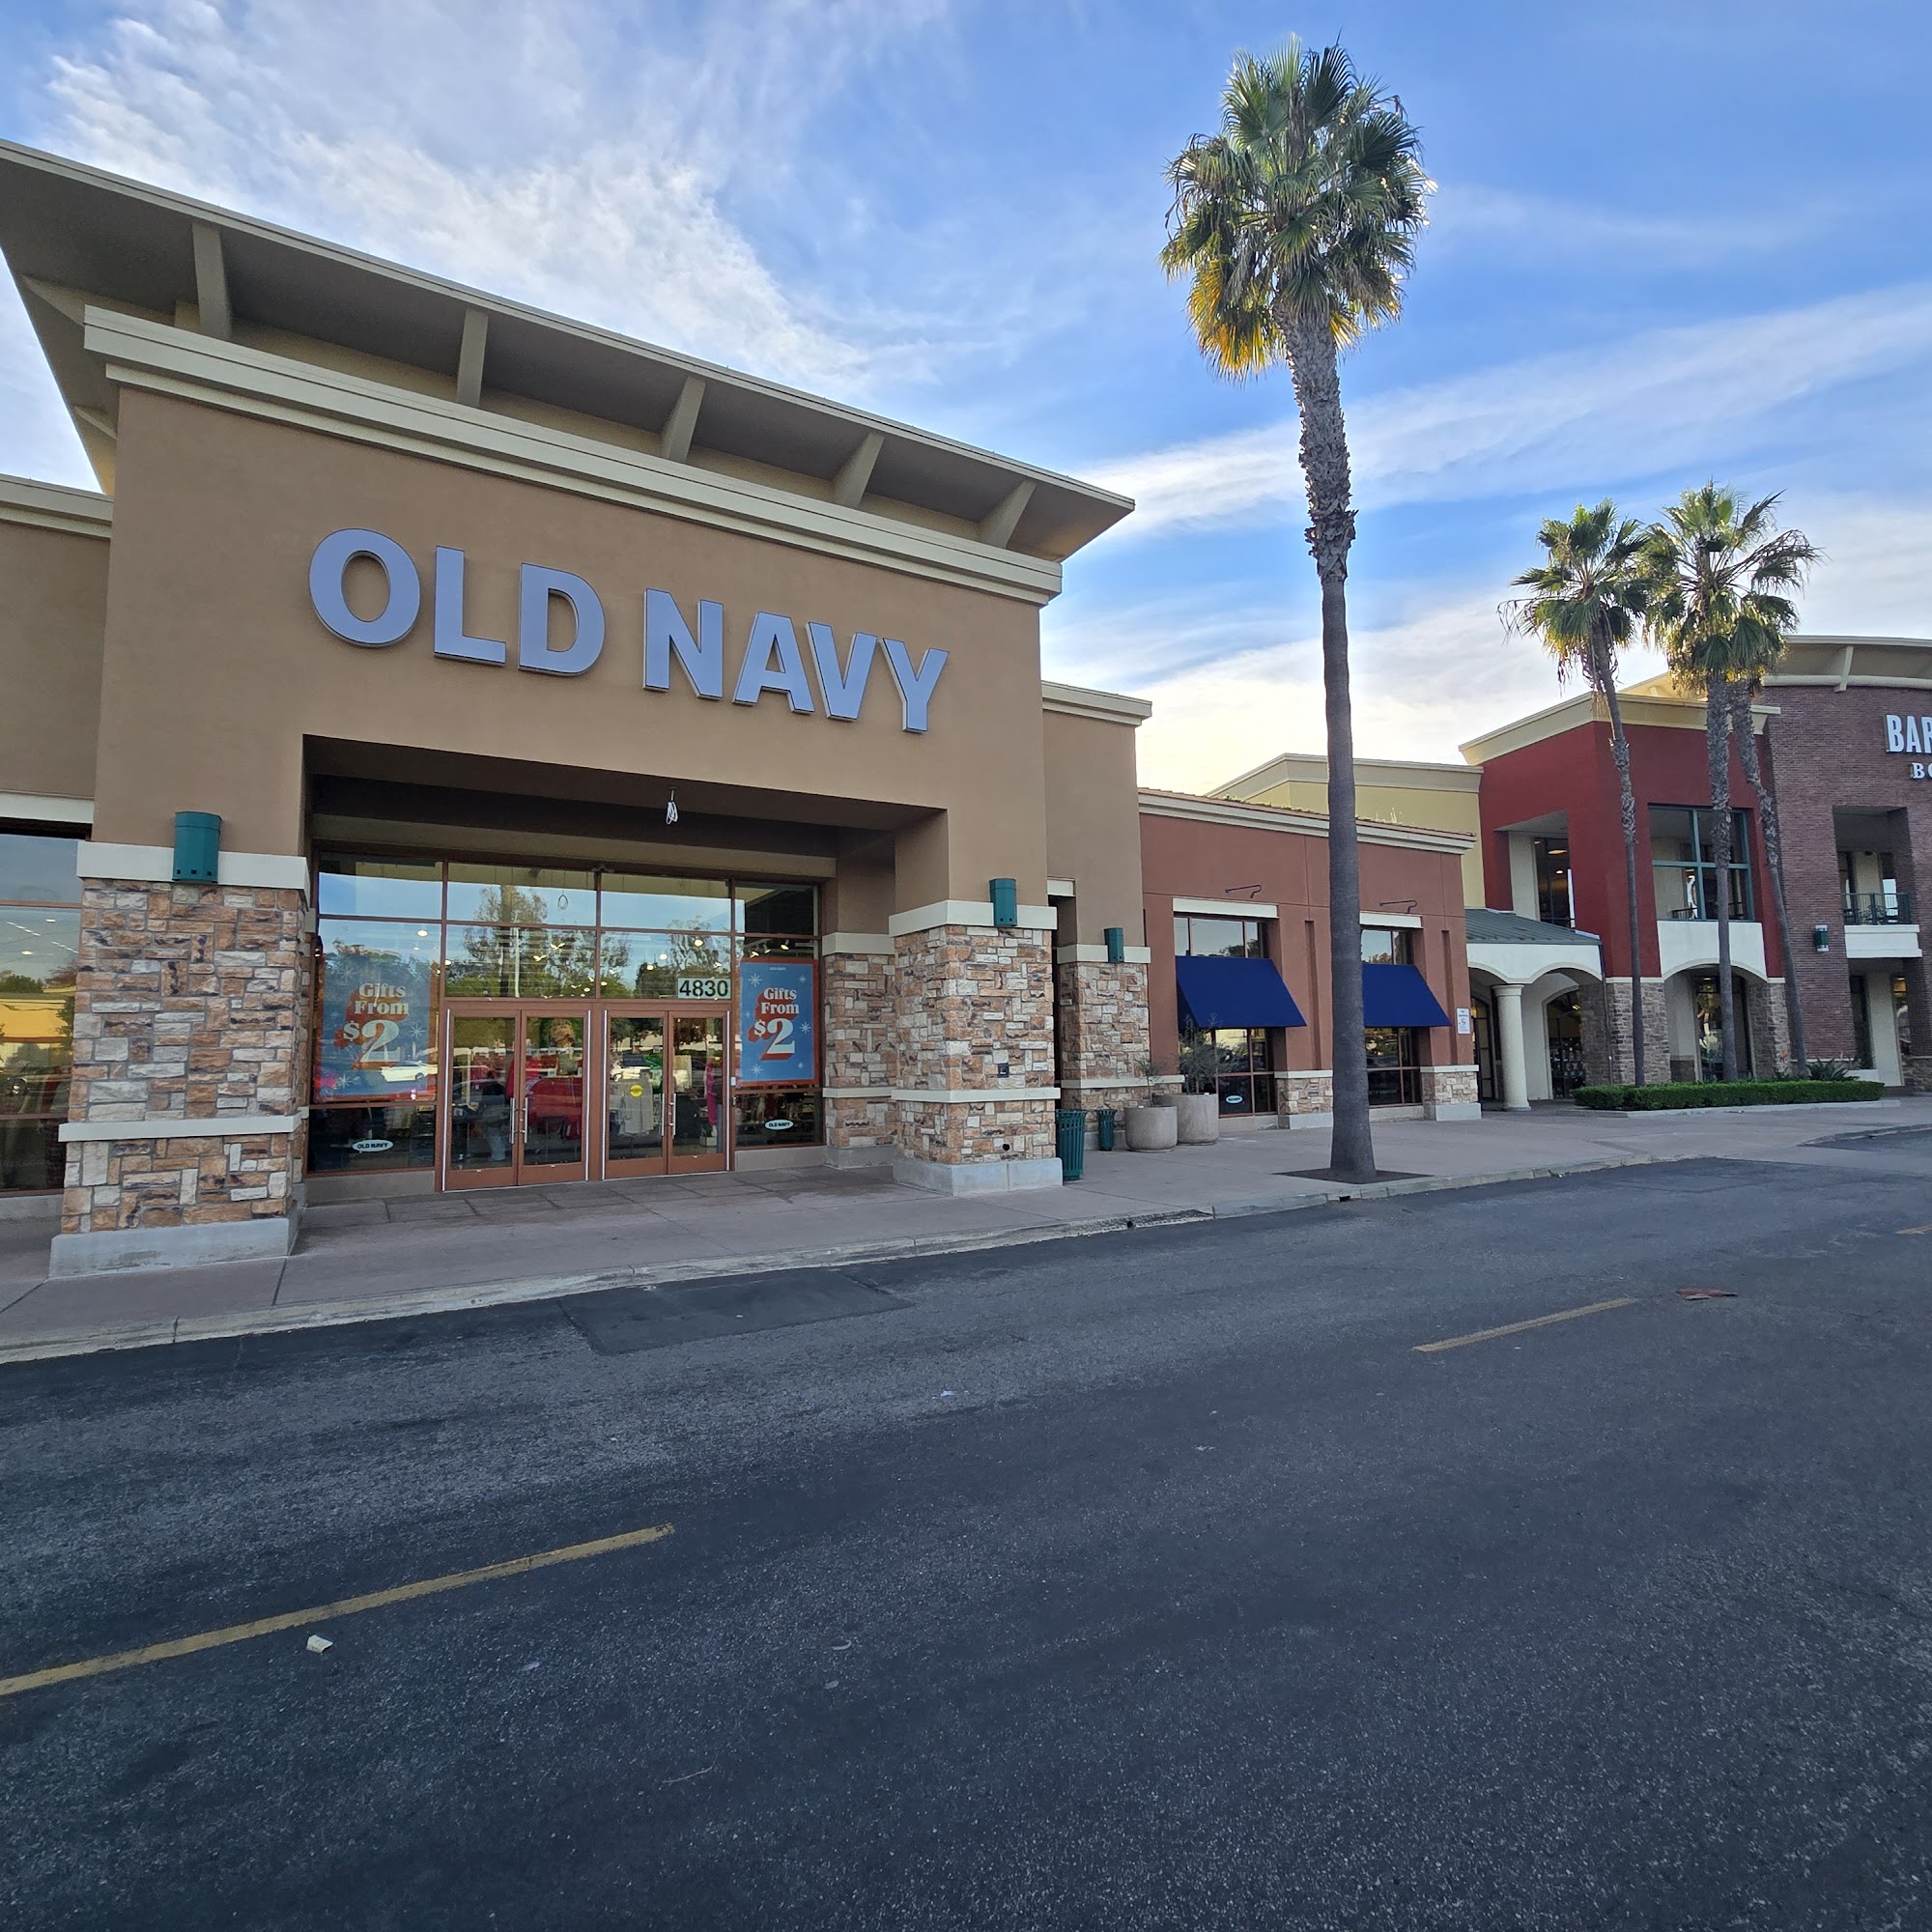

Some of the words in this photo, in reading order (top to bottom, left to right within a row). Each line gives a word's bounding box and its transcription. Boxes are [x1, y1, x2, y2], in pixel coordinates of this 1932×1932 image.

[309, 527, 606, 675] OLD
[642, 587, 950, 733] NAVY
[358, 982, 407, 998] Gifts
[679, 980, 728, 997] 4830
[763, 987, 797, 1001] Gifts
[354, 1000, 410, 1015] From
[760, 1002, 800, 1014] From
[343, 1019, 401, 1063] $2
[753, 1017, 795, 1054] $2
